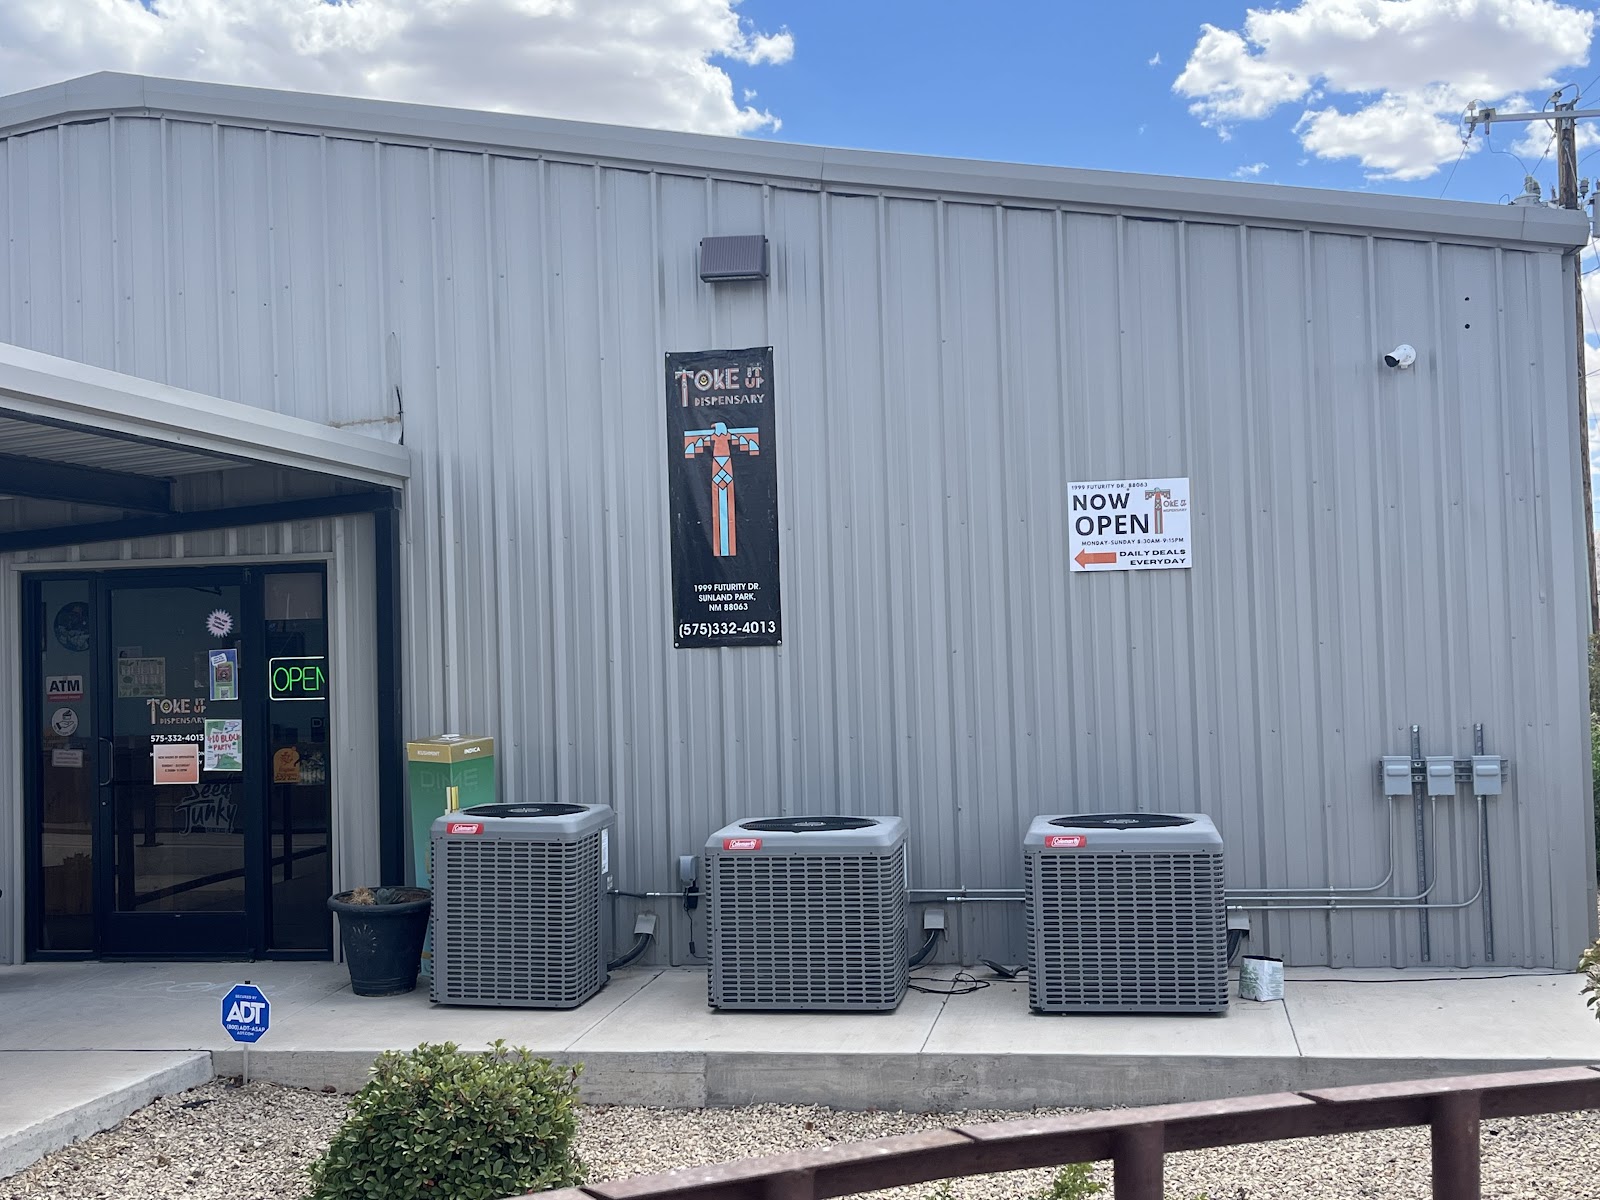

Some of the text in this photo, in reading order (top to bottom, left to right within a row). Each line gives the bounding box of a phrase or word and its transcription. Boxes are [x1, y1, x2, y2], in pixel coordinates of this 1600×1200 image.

[675, 364, 763, 407] TOKE IT
[745, 377, 765, 389] UP
[694, 394, 765, 407] DISPENSARY
[1073, 493, 1130, 511] NOW
[1075, 514, 1149, 536] OPEN
[1130, 558, 1186, 566] EVERYDAY
[694, 582, 761, 592] 1999 FUTURITY DR.
[698, 593, 756, 602] SUNLAND PARK,
[724, 603, 748, 611] 88063
[679, 621, 776, 638] (575)332-4013
[273, 666, 325, 691] OPEN
[50, 680, 80, 692] ATM
[147, 698, 206, 724] TOKE IT
[194, 705, 206, 713] UP
[150, 734, 204, 742] 575-332-4013
[464, 746, 481, 754] INDICA
[175, 797, 237, 835] Junky
[226, 1001, 265, 1024] ADT
